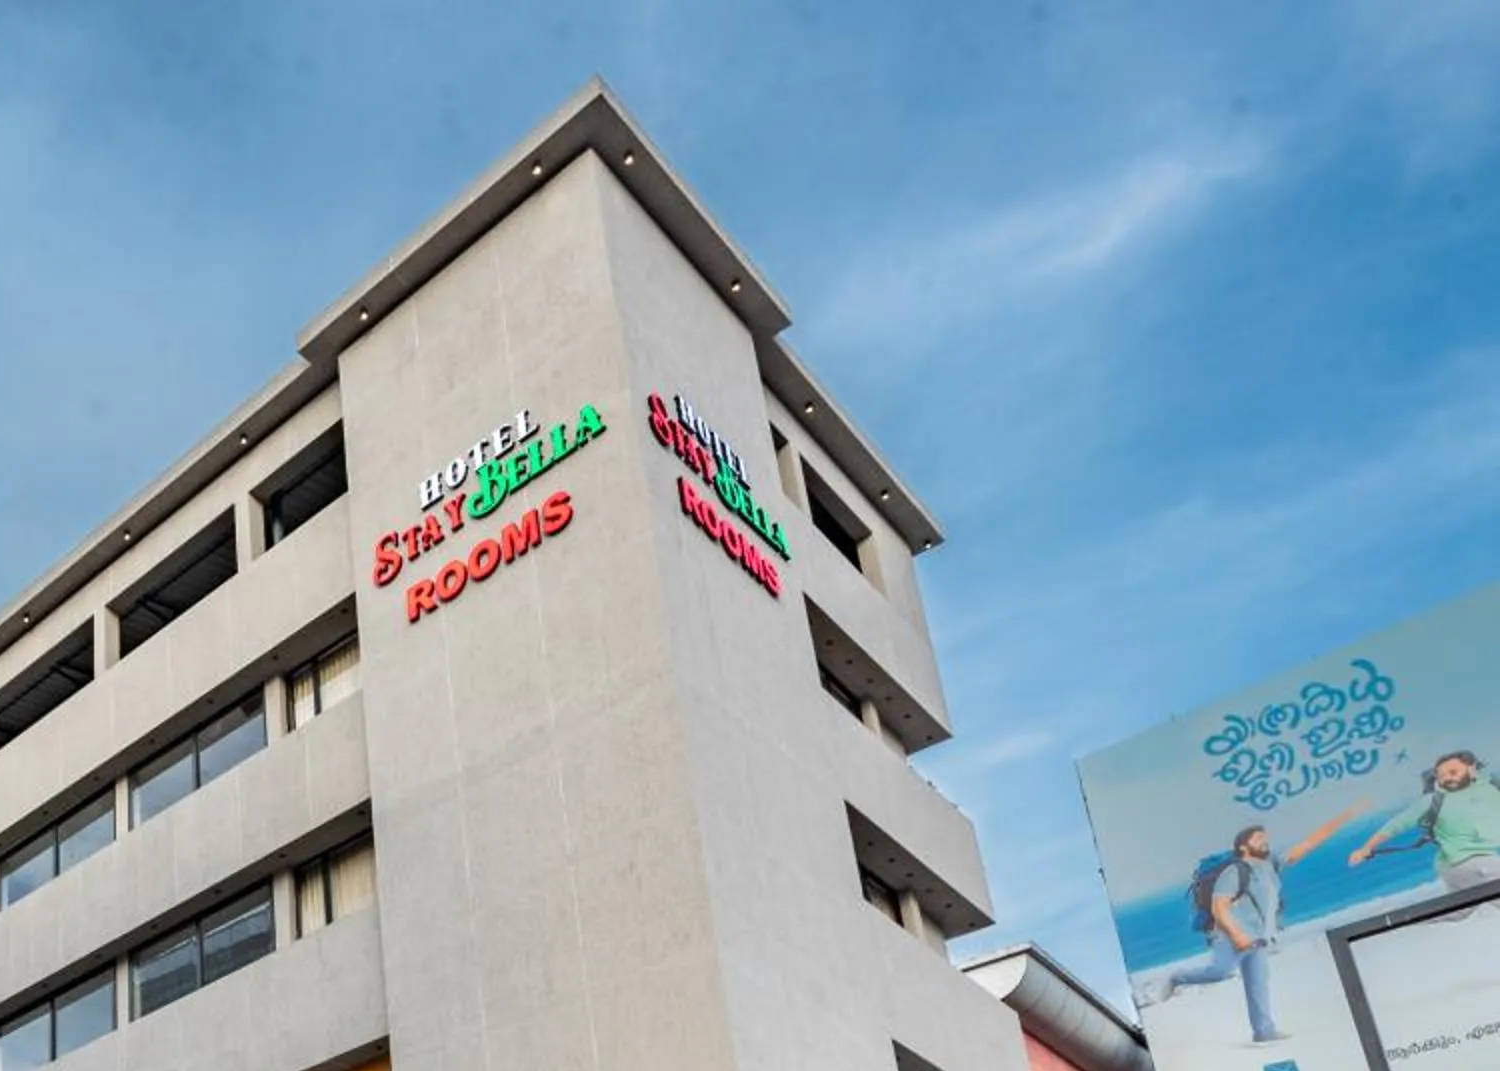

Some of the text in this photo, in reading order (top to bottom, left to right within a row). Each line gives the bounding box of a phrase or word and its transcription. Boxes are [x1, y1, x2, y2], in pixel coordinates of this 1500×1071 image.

[372, 403, 608, 588] STAY BELLA
[419, 409, 541, 511] HOTEL
[648, 387, 791, 560] STAY BELLA
[674, 394, 752, 491] HOTEL
[404, 489, 574, 625] ROOMS
[676, 476, 787, 599] ROOMS
